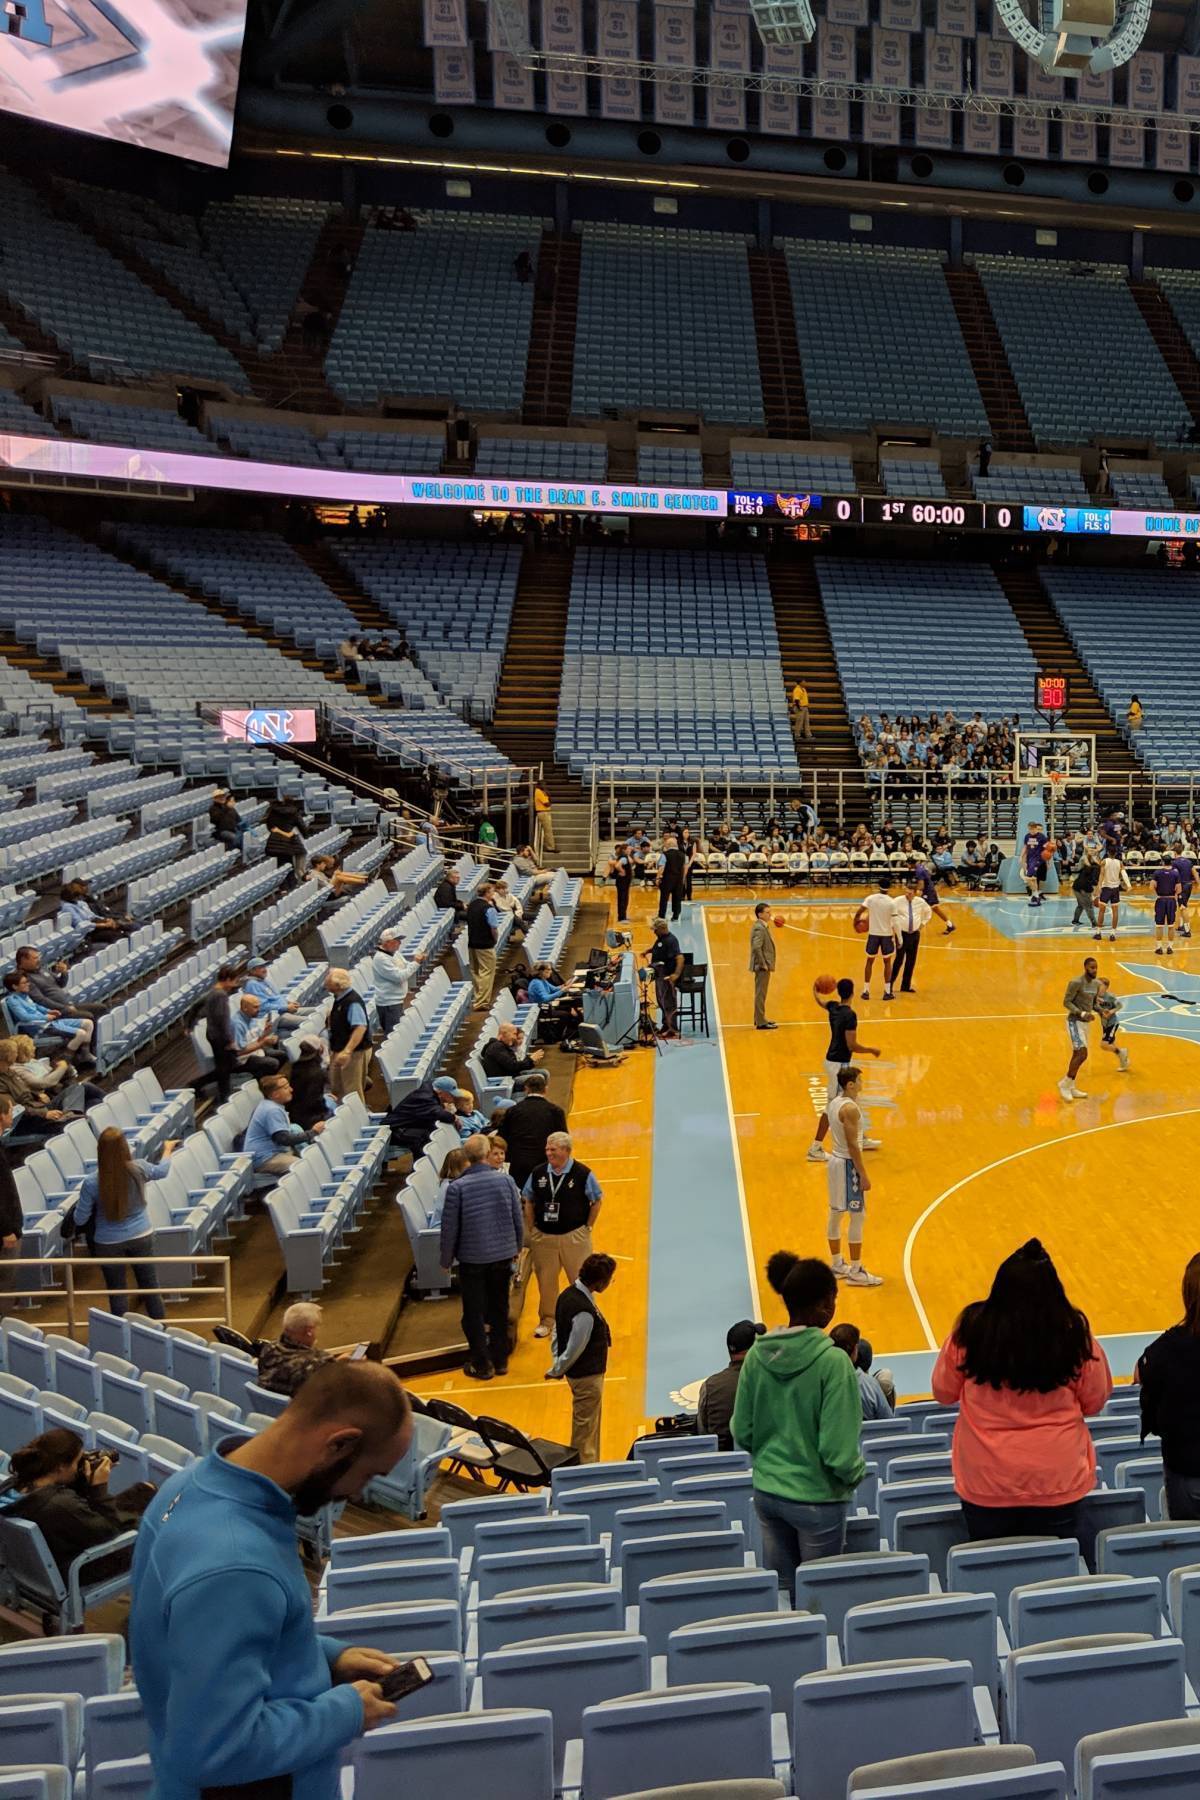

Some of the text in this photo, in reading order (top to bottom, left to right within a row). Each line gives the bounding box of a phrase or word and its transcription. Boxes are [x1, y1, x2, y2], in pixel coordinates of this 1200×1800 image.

[412, 483, 719, 511] WELCOME TO THE DEAN E. SMITH CENTER
[734, 495, 764, 506] TOL: 4
[734, 505, 764, 515] FLS: 0
[836, 500, 851, 520] 0
[882, 503, 965, 525] 1ST 60:00
[998, 508, 1011, 528] 0
[1084, 512, 1111, 522] TOL: 4
[1084, 521, 1111, 531] FLS: 0
[1146, 517, 1181, 533] HOME
[1185, 518, 1200, 533] OF
[1042, 689, 1063, 706] 30
